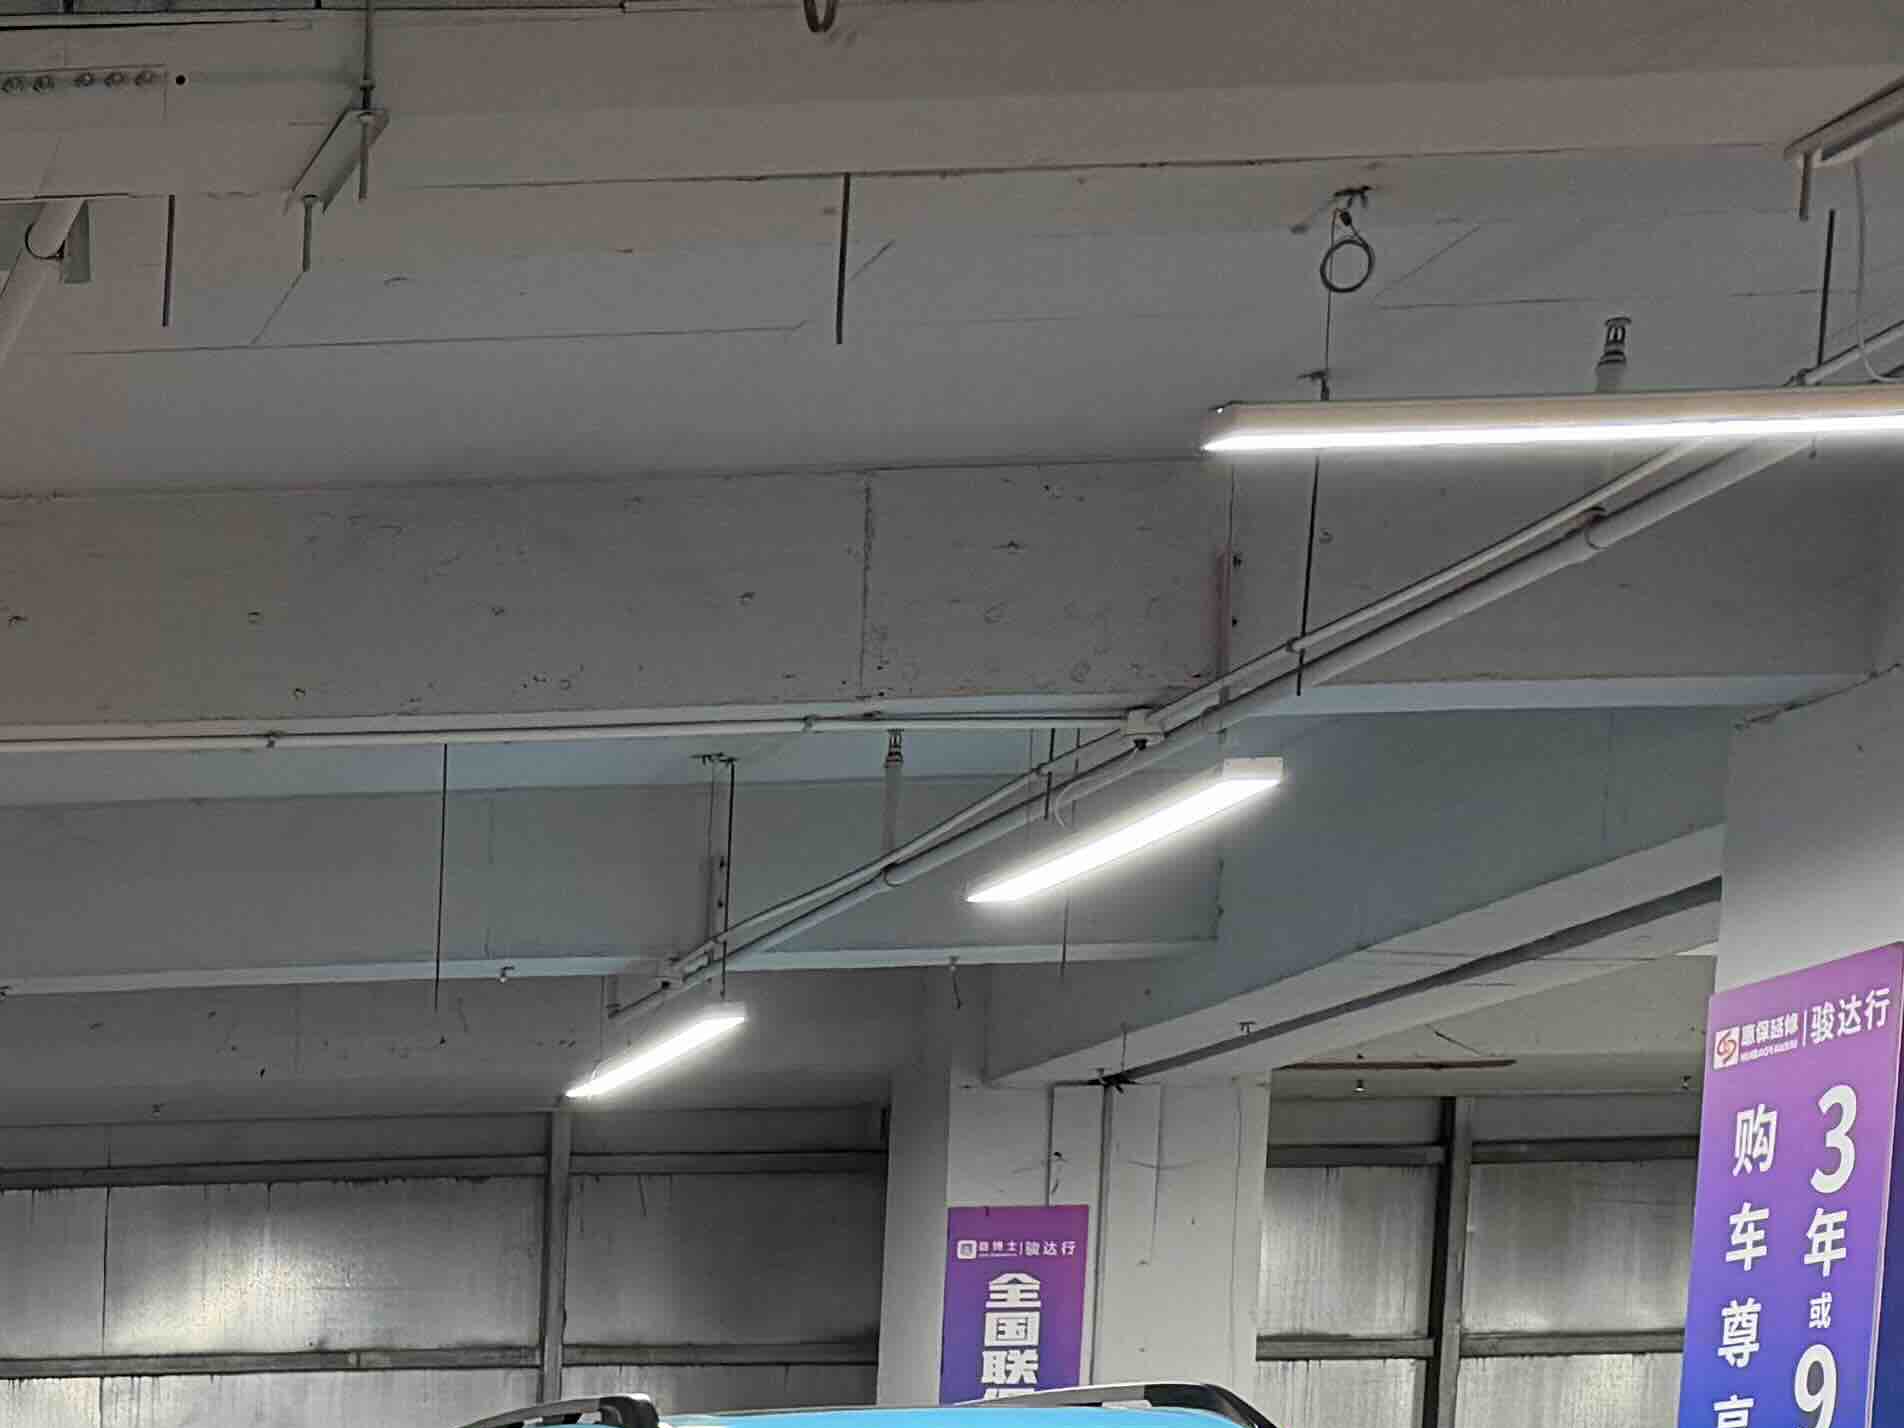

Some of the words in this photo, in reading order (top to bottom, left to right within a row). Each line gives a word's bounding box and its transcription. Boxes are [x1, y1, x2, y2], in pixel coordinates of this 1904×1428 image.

[1810, 988, 1891, 1044] 骏达行
[1025, 1240, 1077, 1256] 骏达行
[981, 1273, 1042, 1399] 全国联
